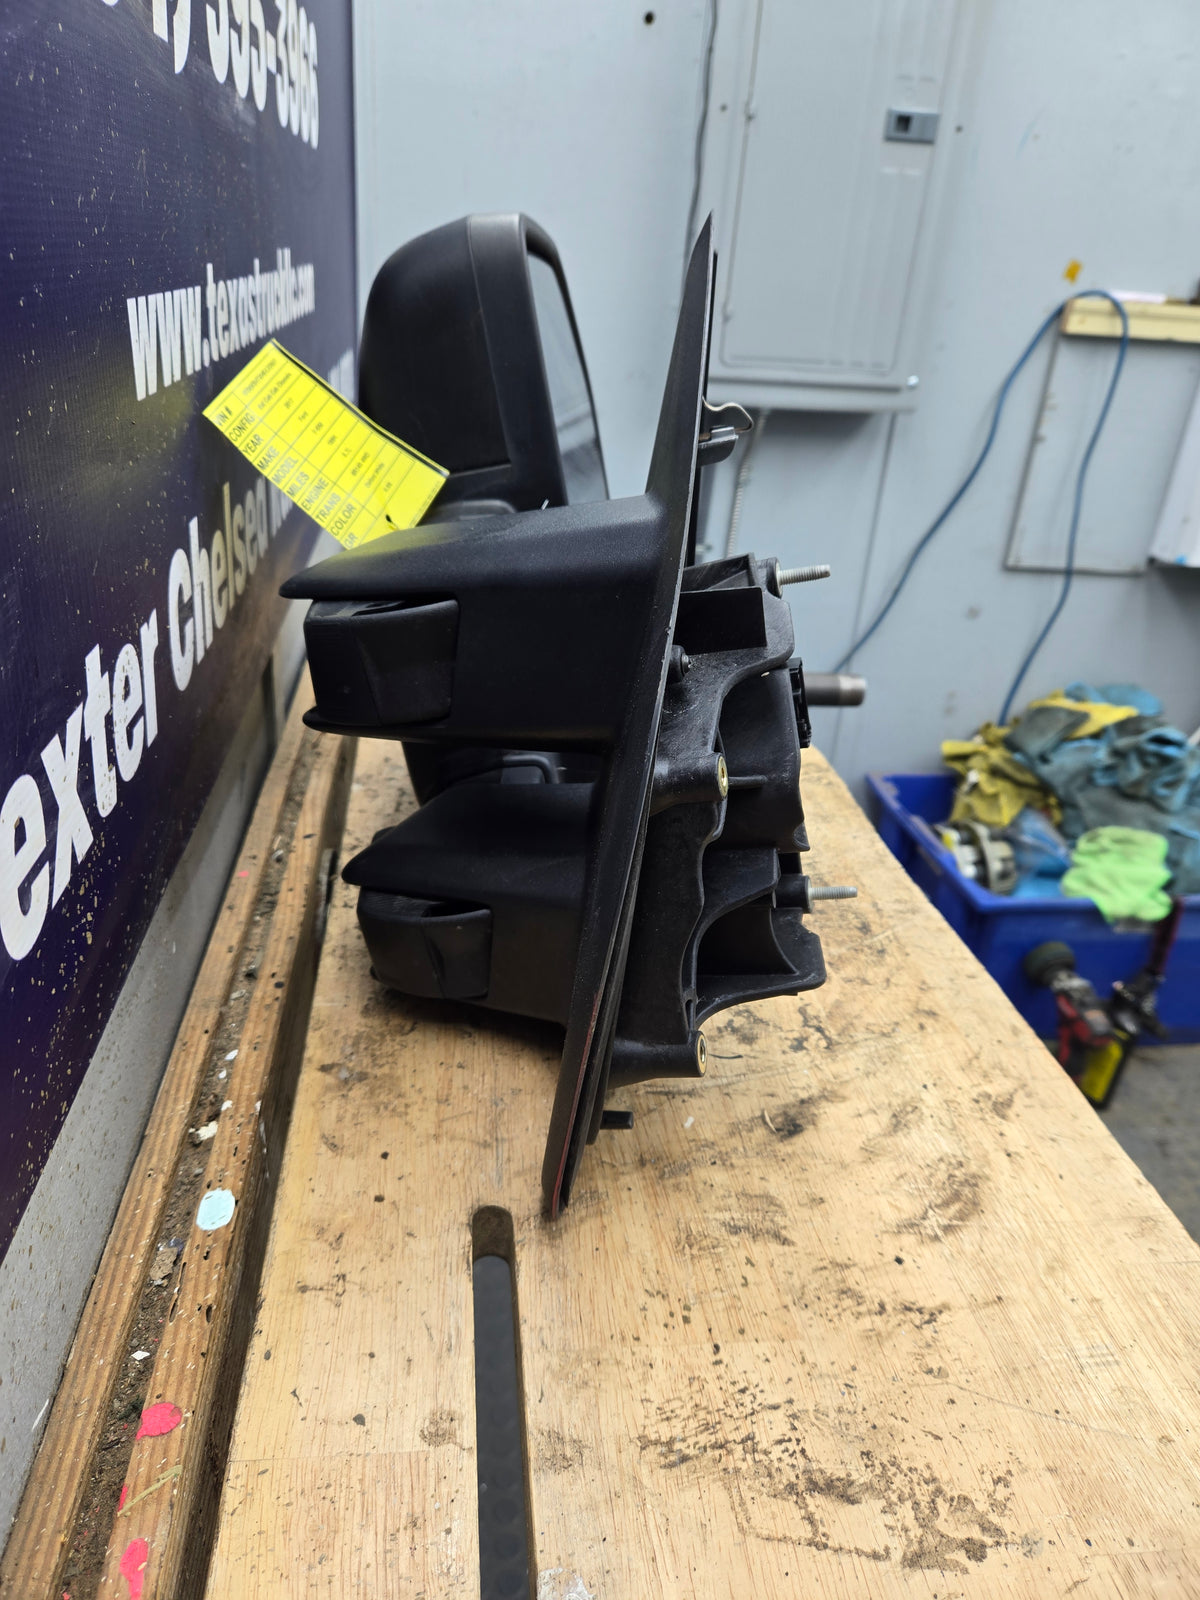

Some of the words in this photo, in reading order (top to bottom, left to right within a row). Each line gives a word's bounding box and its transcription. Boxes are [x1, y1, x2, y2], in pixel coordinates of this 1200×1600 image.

[228, 412, 256, 442] CONFIG
[242, 433, 264, 457] YEAR
[256, 445, 280, 470] MAKE
[271, 456, 299, 486] MODEL
[287, 471, 310, 498] MILES
[301, 477, 329, 512] ENGINE
[315, 492, 341, 523] TRANS
[330, 504, 356, 537] COLOR
[168, 474, 269, 692] Chelsea
